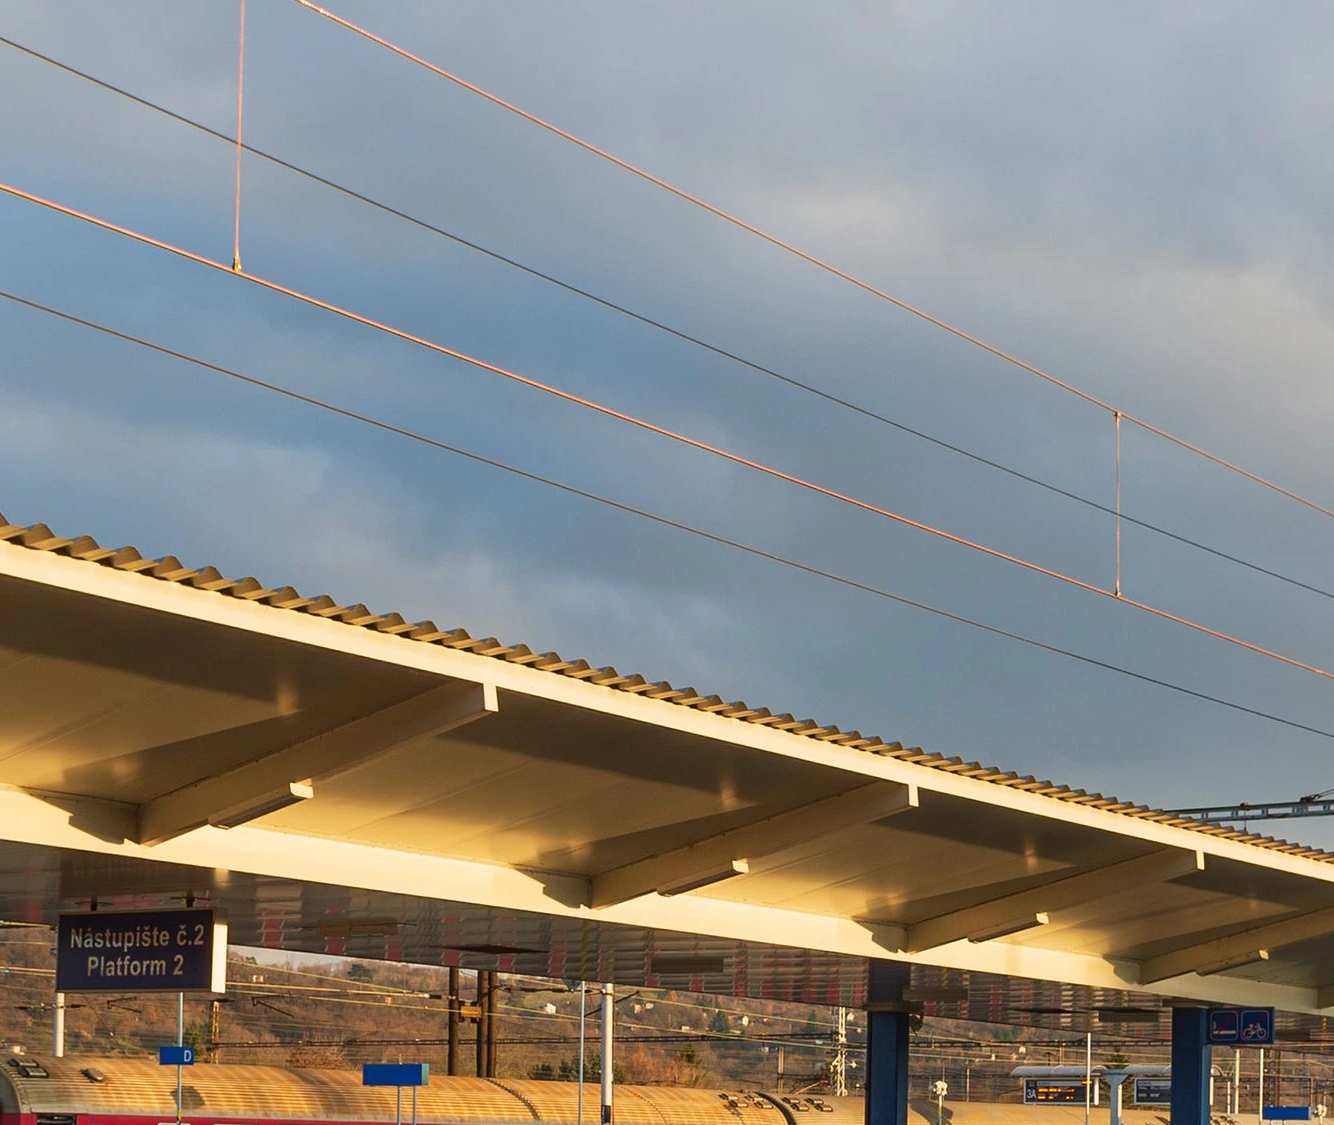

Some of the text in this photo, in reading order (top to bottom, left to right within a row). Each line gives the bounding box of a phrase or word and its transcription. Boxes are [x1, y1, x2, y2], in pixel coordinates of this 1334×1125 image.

[70, 924, 205, 952] Nástupište č.2
[87, 954, 185, 977] Platform 2
[184, 1050, 192, 1062] D
[1027, 1089, 1036, 1098] 3A
